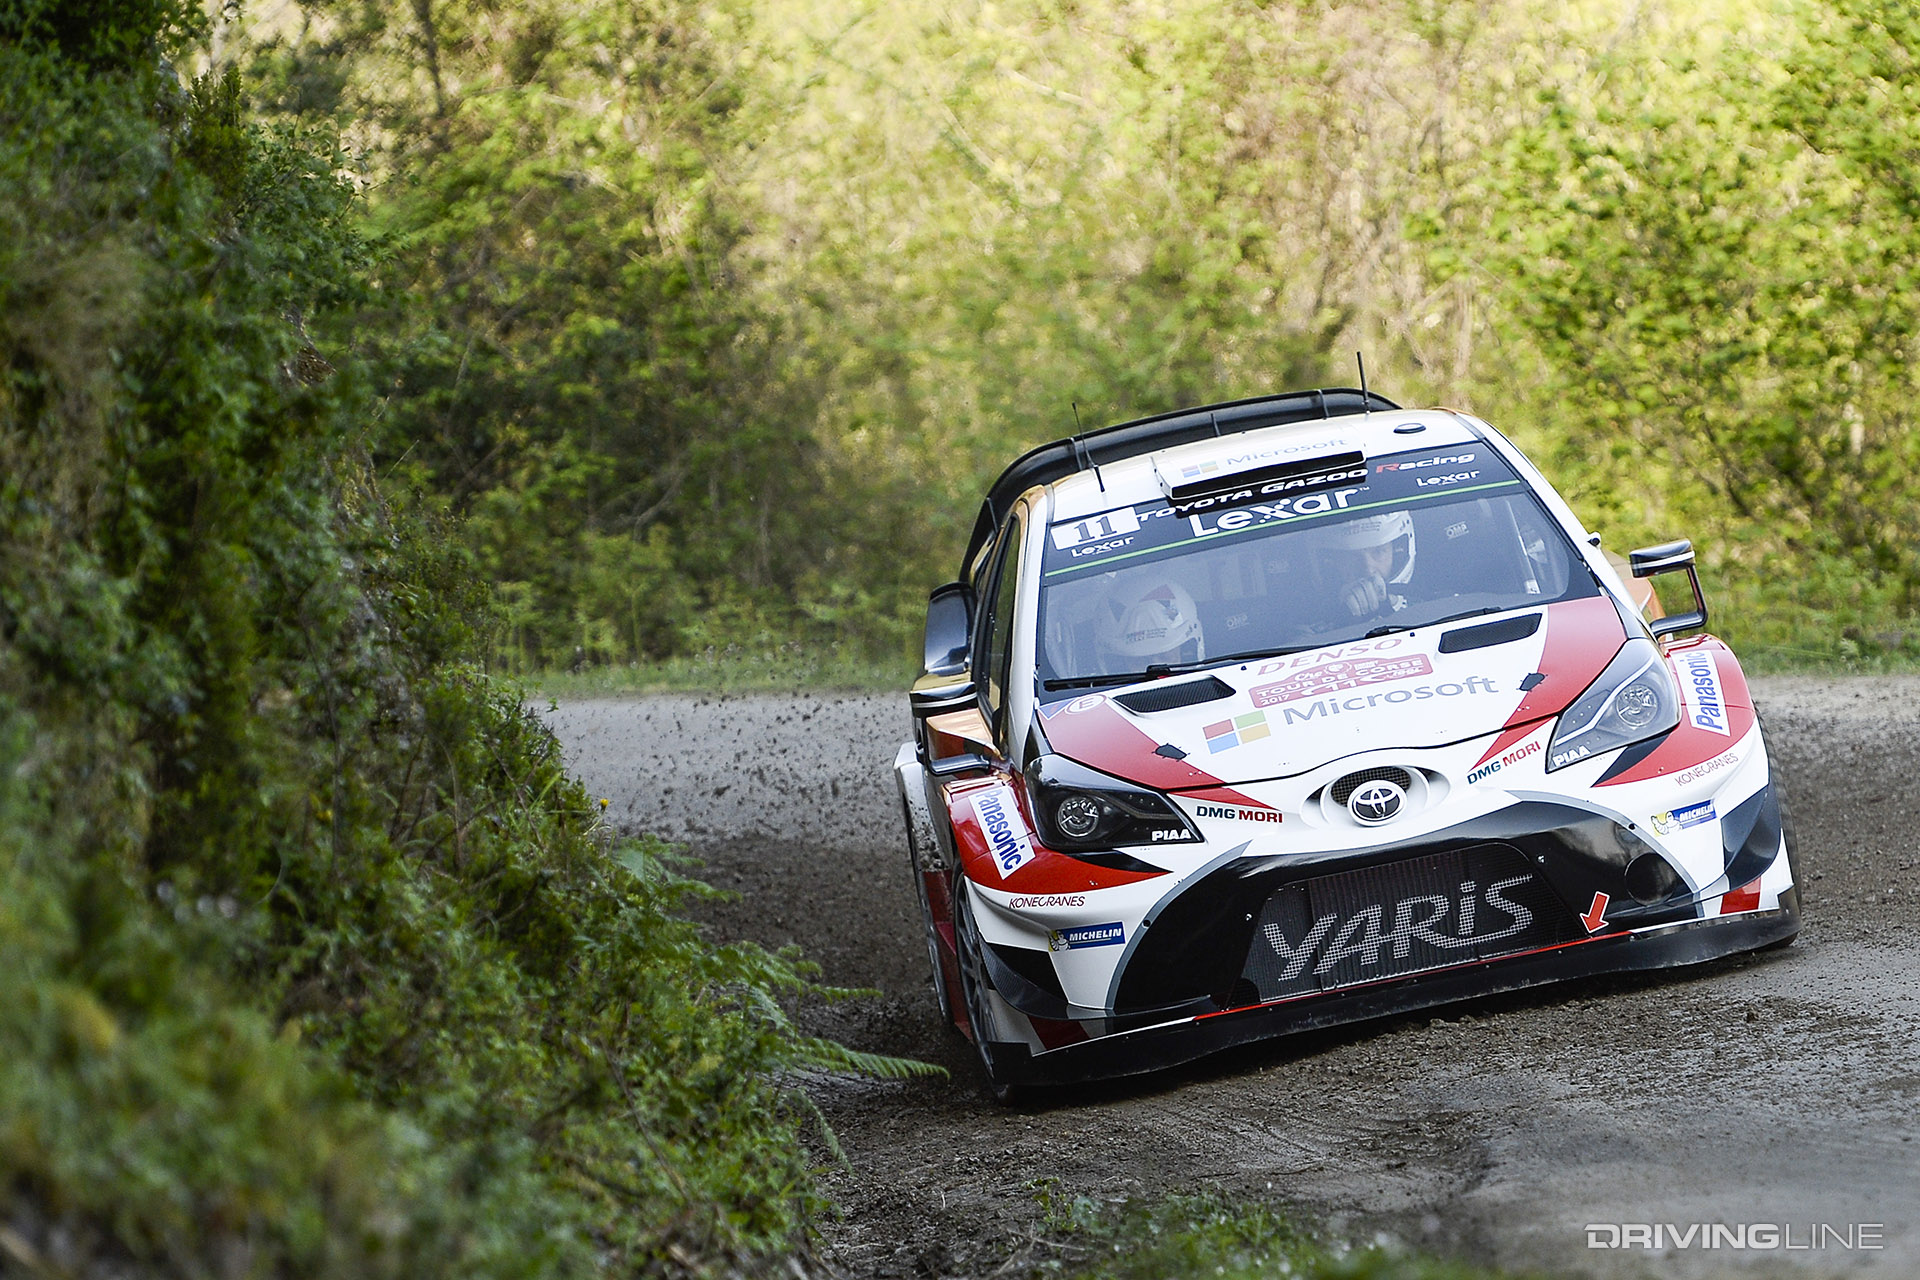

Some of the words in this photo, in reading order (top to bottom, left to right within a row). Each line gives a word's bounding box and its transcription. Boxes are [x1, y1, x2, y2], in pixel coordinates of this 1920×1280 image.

[1226, 438, 1348, 465] Microsoft
[1136, 489, 1253, 522] TOYOTA
[1260, 468, 1369, 494] GAZOO
[1376, 453, 1476, 474] Racing
[1416, 470, 1480, 488] Lexar
[1188, 488, 1360, 537] Lexar
[1073, 516, 1117, 543] 11
[1070, 536, 1135, 558] Lexar
[1257, 639, 1403, 676] DENSO
[1256, 681, 1315, 698] TOUR
[1322, 673, 1349, 684] DE
[1355, 659, 1424, 676] CORSE
[1680, 651, 1723, 730] Panasonic
[1260, 693, 1290, 706] 2017
[1283, 676, 1499, 725] Microsoft
[1466, 760, 1502, 785] DMG
[1502, 741, 1541, 768] MORI
[1552, 745, 1592, 768] PIAA
[1674, 752, 1739, 787] KONECRANES
[1196, 806, 1236, 820] DMG
[1238, 809, 1283, 823] MORI
[974, 789, 1024, 871] Panasonic
[1151, 828, 1192, 842] PIAA
[1008, 894, 1086, 909] KONECRANES
[1069, 927, 1123, 944] MICHELIN
